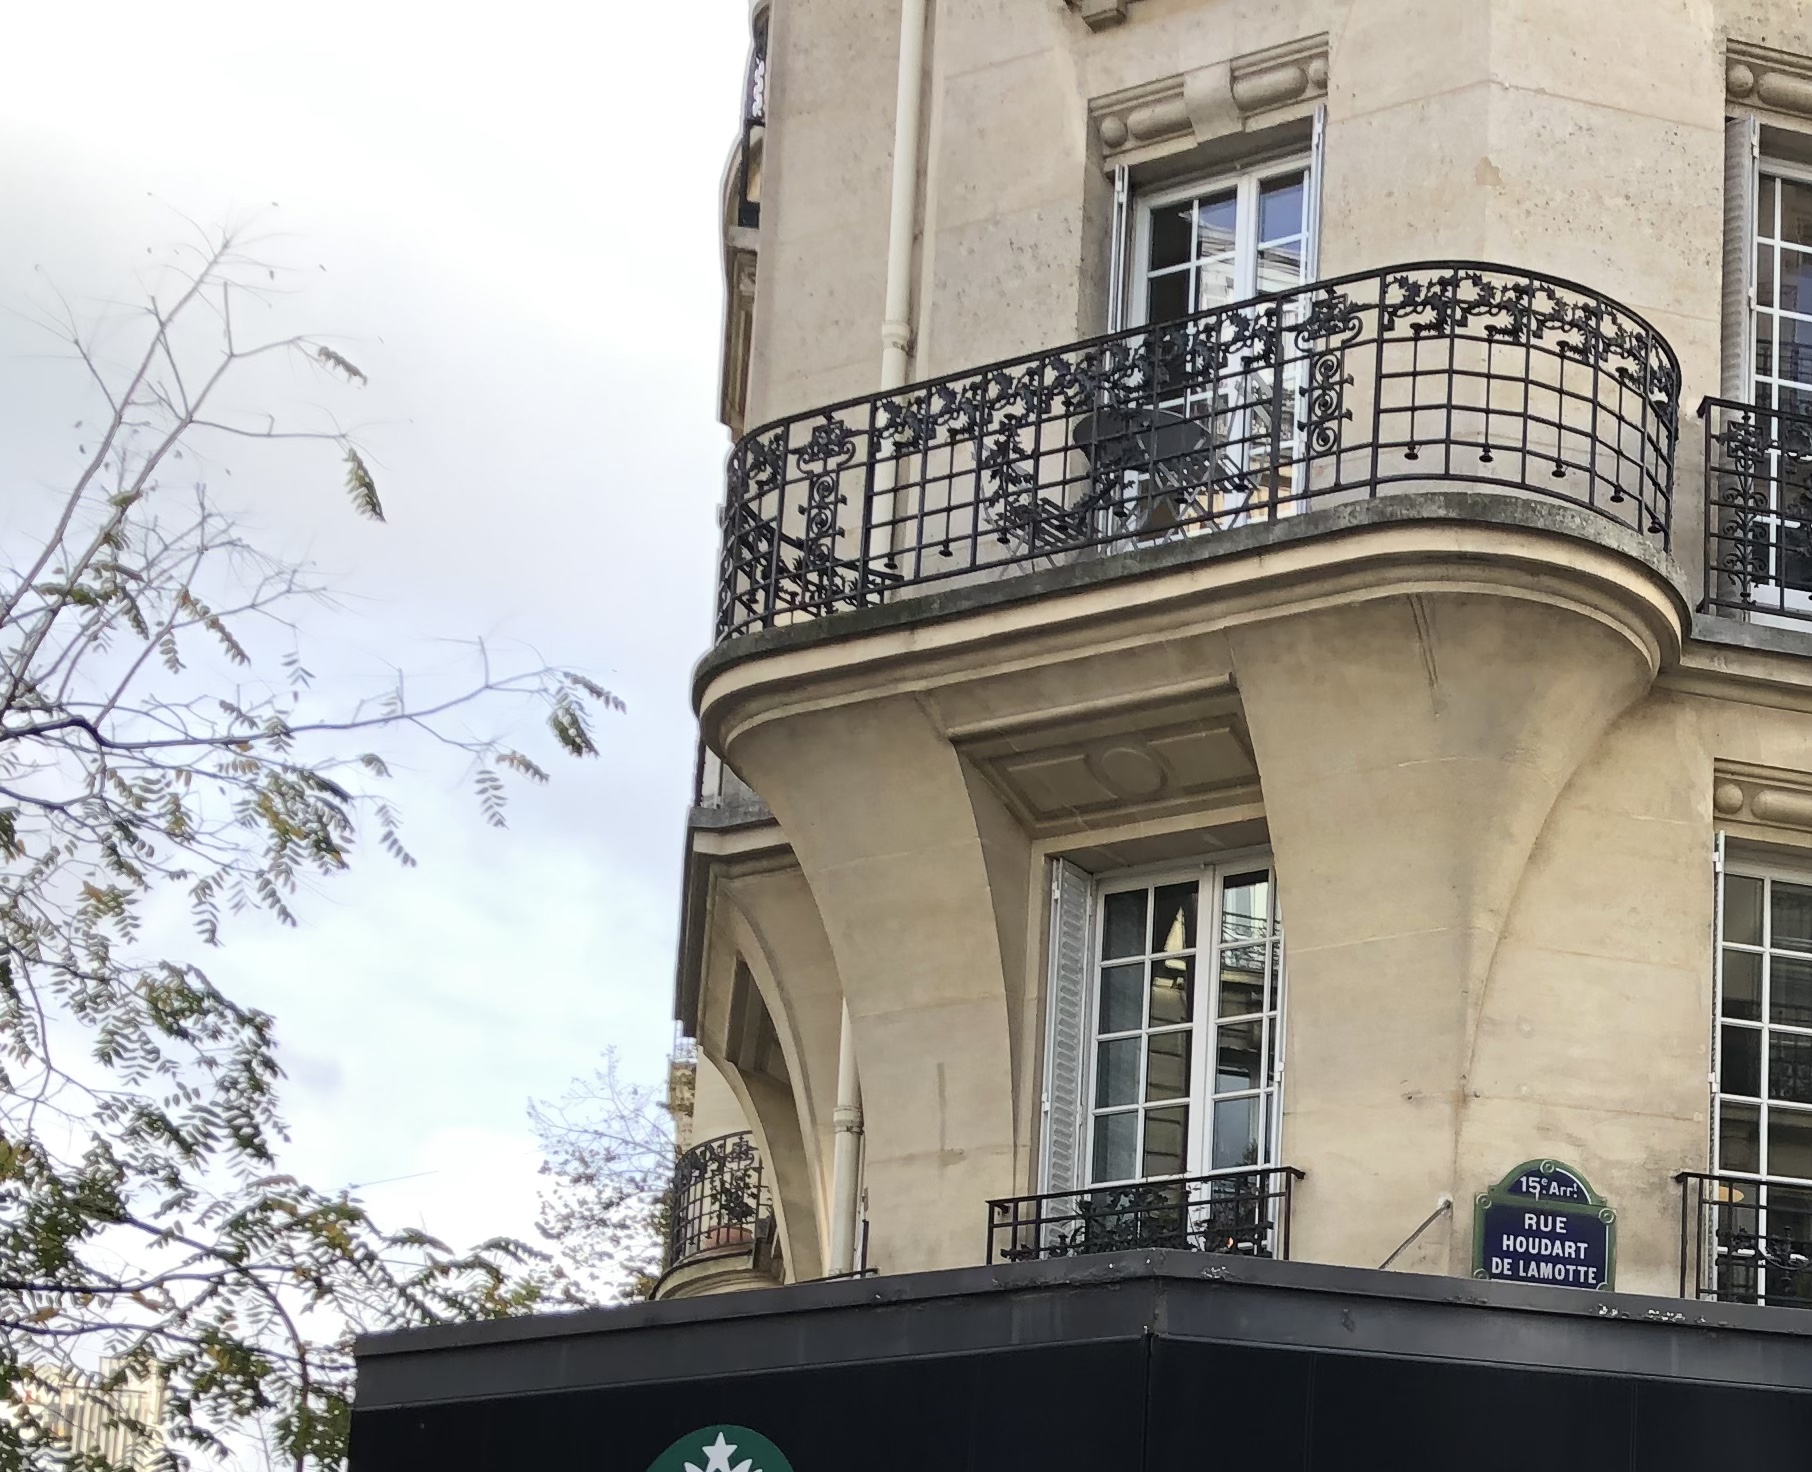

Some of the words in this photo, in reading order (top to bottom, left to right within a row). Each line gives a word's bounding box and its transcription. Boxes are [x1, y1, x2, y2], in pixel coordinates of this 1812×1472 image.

[1524, 1213, 1567, 1235] RUE
[1502, 1234, 1588, 1260] HOUDART
[1491, 1257, 1512, 1276] DE
[1518, 1259, 1597, 1285] LAMOTTE
